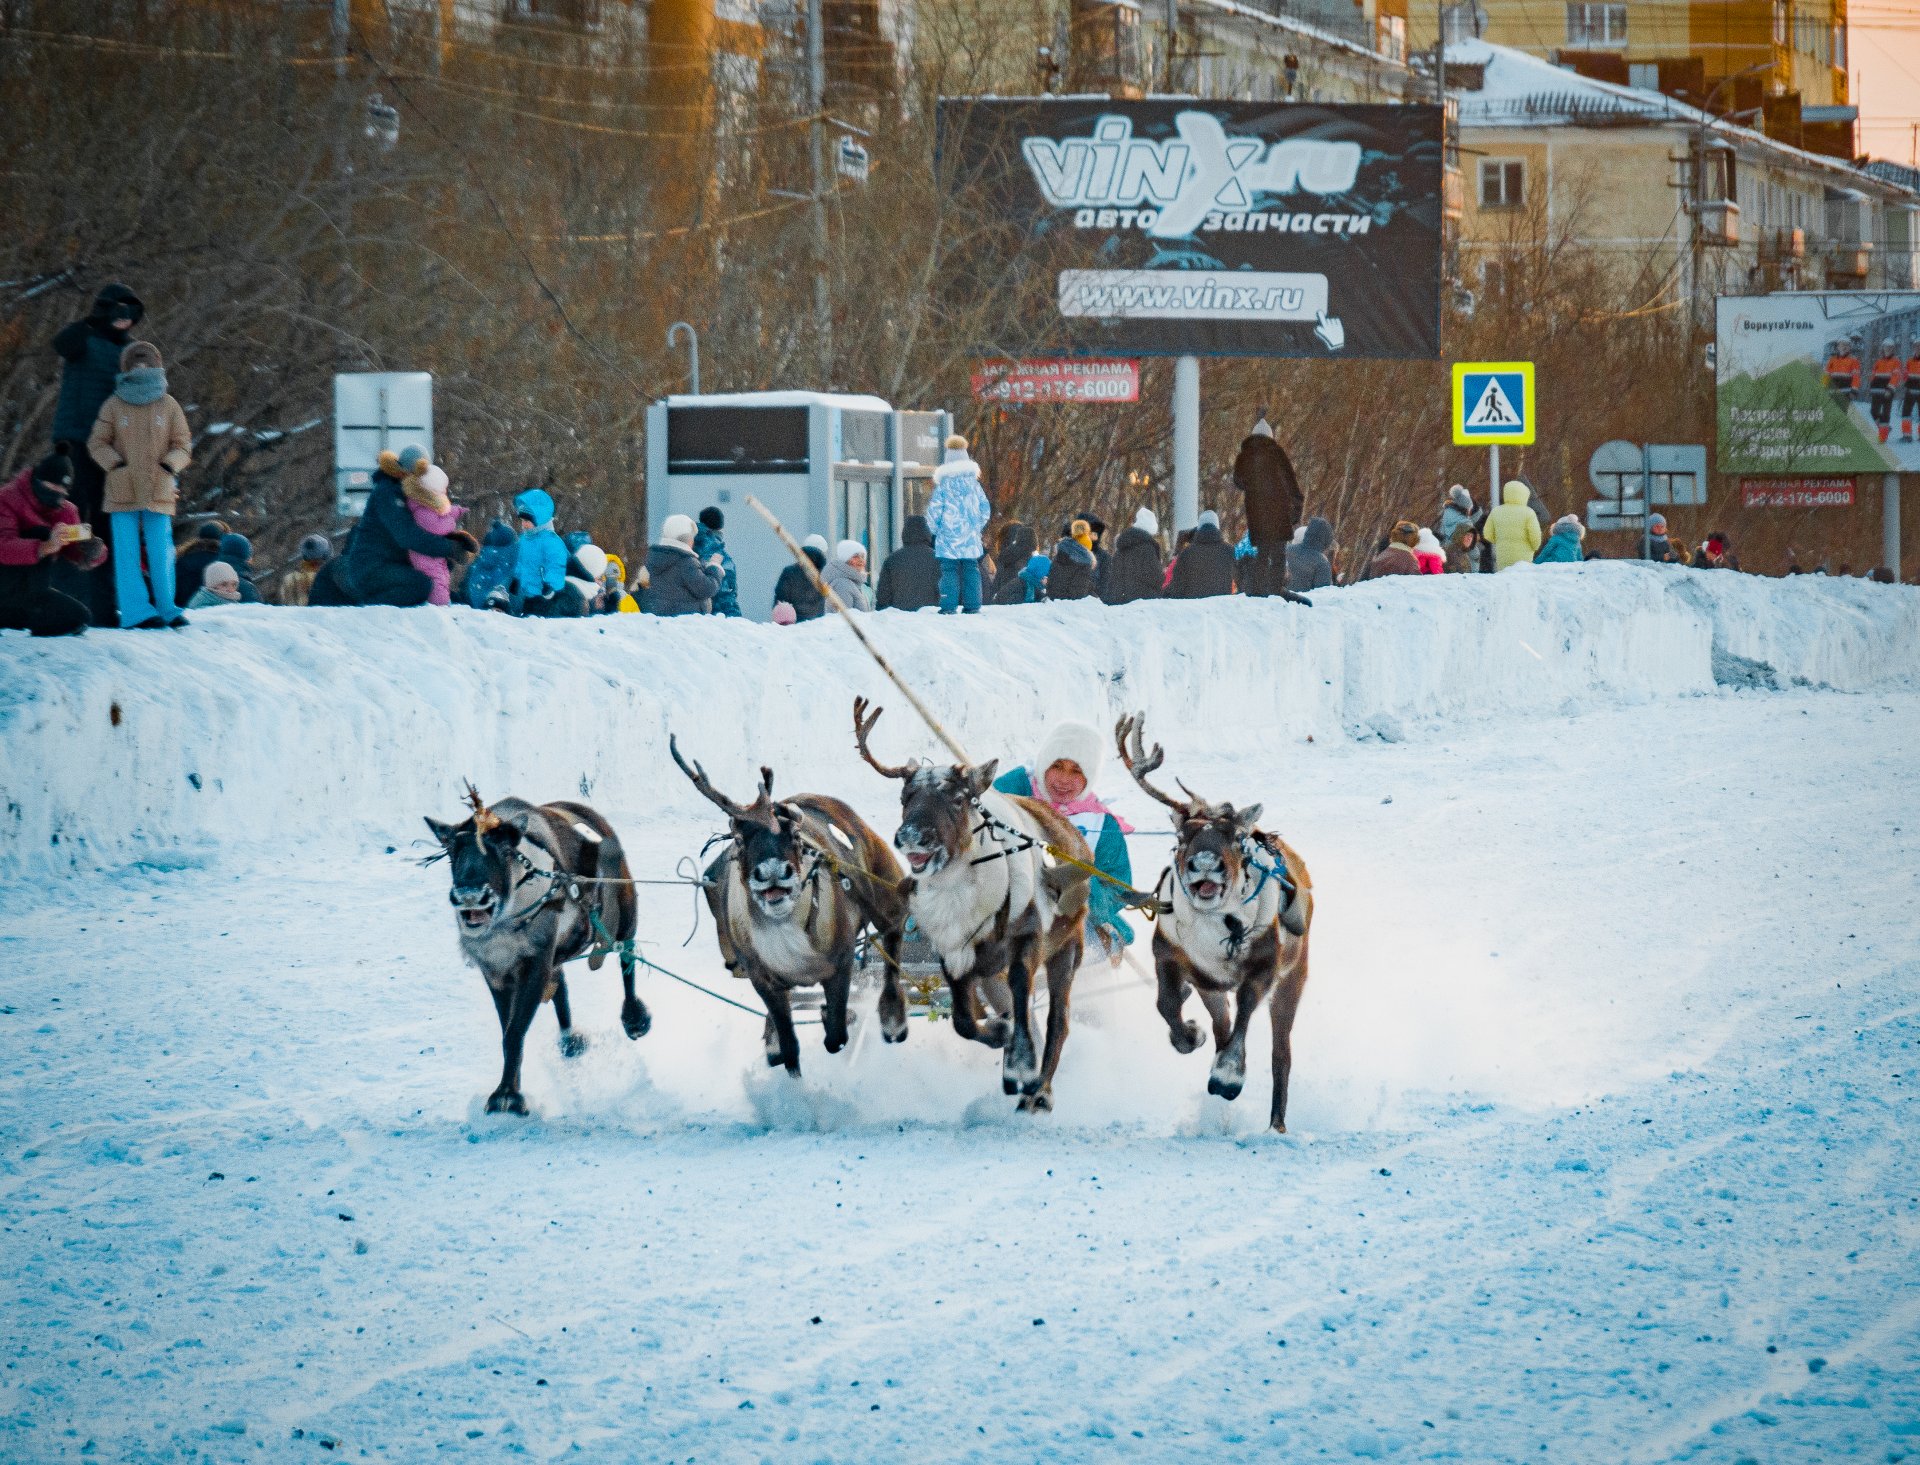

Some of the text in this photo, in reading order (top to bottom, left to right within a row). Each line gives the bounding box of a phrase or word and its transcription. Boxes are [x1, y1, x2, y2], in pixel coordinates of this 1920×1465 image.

[1203, 210, 1372, 234] запчасти
[1081, 278, 1304, 312] www.vinx.ru
[1743, 319, 1814, 332] ВоркутаУголь
[977, 363, 1132, 377] АРЖНАЯ РЕКЛАМА
[979, 379, 1130, 399] -912-176-6000
